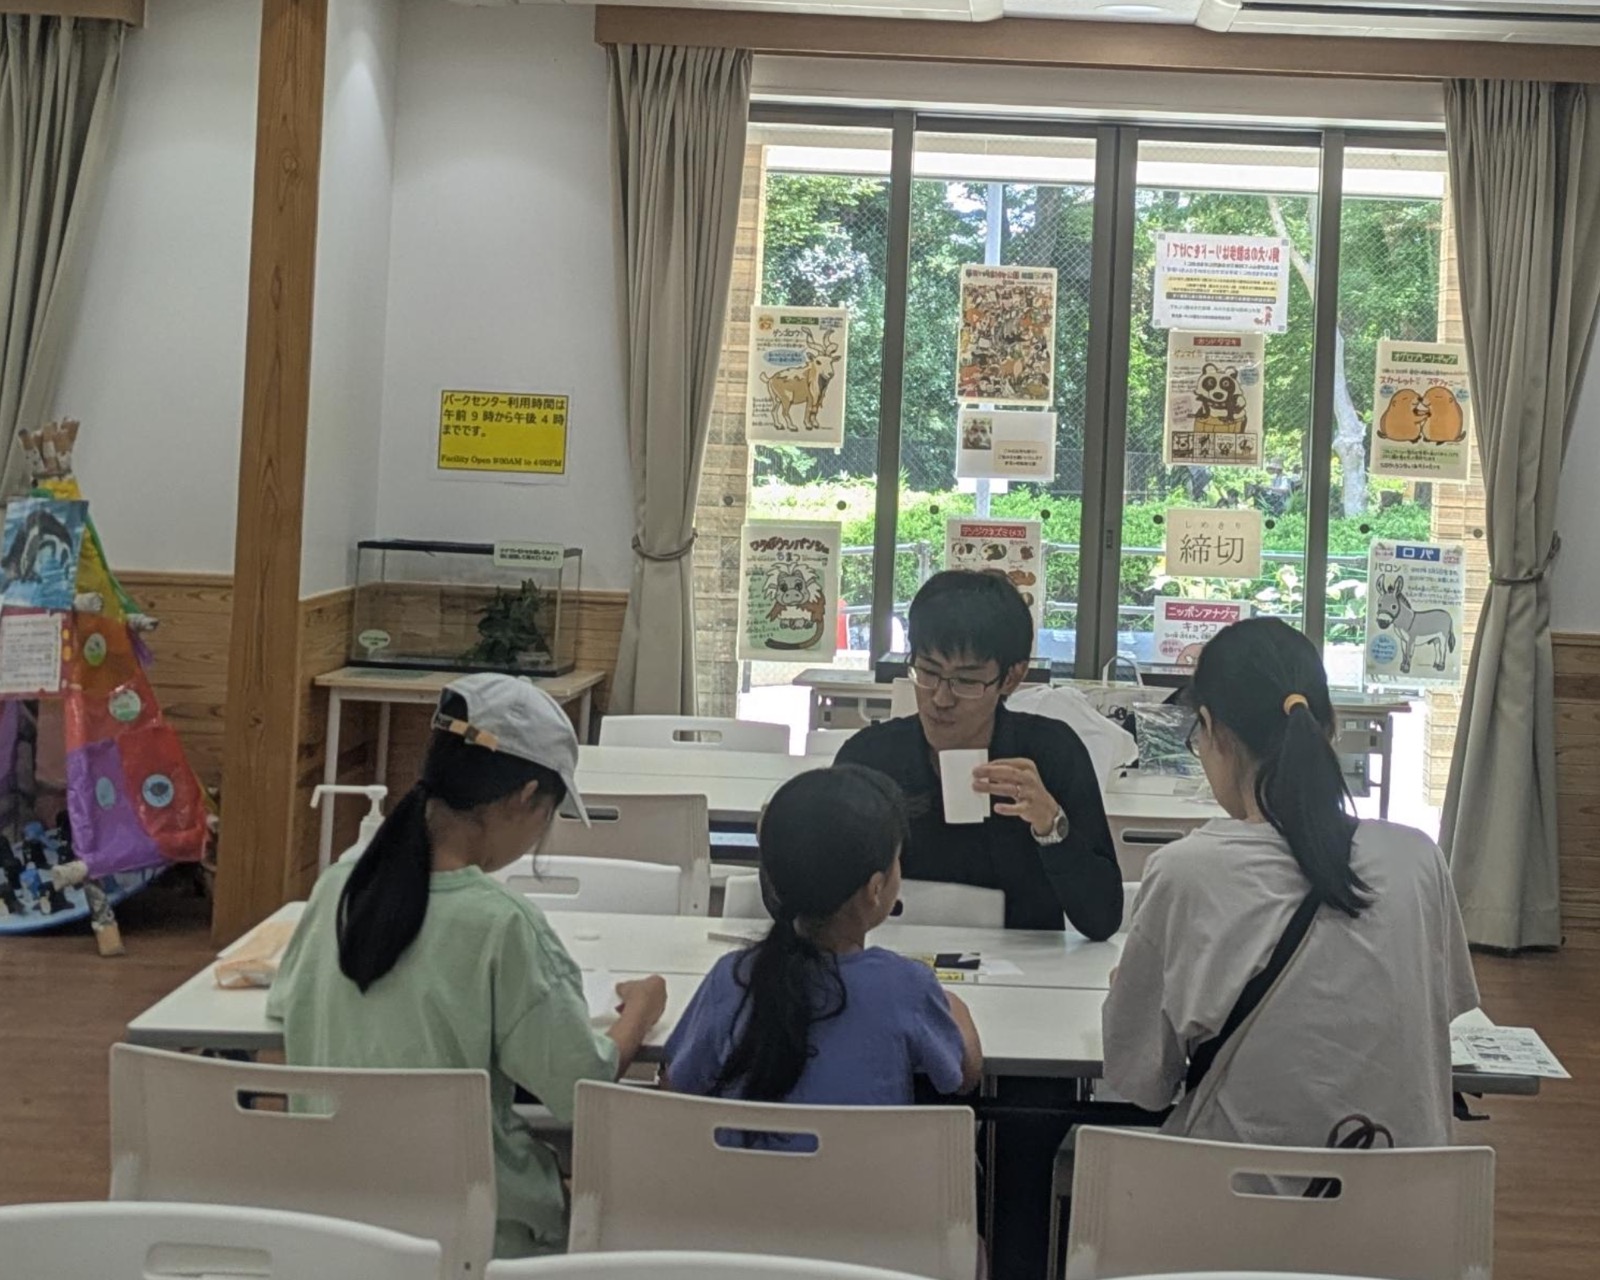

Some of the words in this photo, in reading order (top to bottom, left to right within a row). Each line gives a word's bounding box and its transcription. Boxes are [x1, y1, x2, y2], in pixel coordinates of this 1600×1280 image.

[1380, 376, 1415, 384] スカーレット
[443, 394, 565, 410] パークセンター利用時間は
[442, 425, 486, 437] までです。
[441, 454, 469, 464] Facility
[471, 456, 491, 465] Open
[493, 457, 522, 465] 9:00AM
[533, 458, 562, 466] 4:00PM
[1185, 521, 1241, 530] しめきり
[1179, 533, 1245, 566] 締切
[1402, 548, 1434, 559] ロバ
[1374, 563, 1401, 573] バロン
[1168, 605, 1238, 620] ニッポンアナグマ
[1182, 622, 1218, 633] キョウコ
